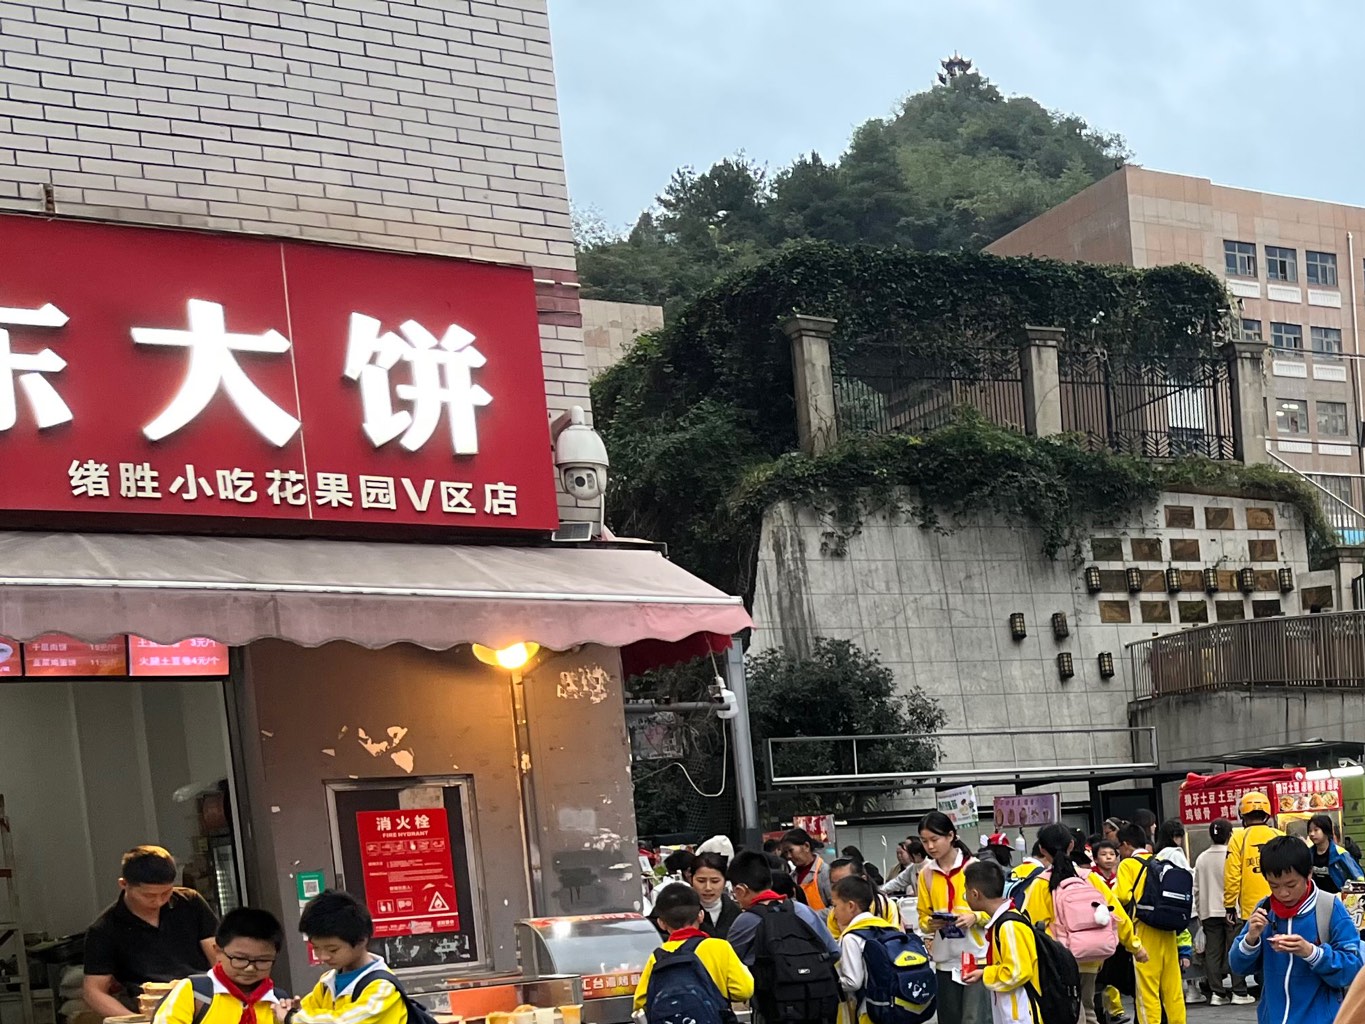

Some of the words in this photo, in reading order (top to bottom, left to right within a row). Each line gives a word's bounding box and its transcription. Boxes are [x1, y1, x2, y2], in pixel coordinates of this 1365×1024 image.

[0, 299, 493, 455] 东大饼
[68, 458, 518, 517] 绪胜小吃花果园V区店
[376, 814, 431, 831] 消火栓
